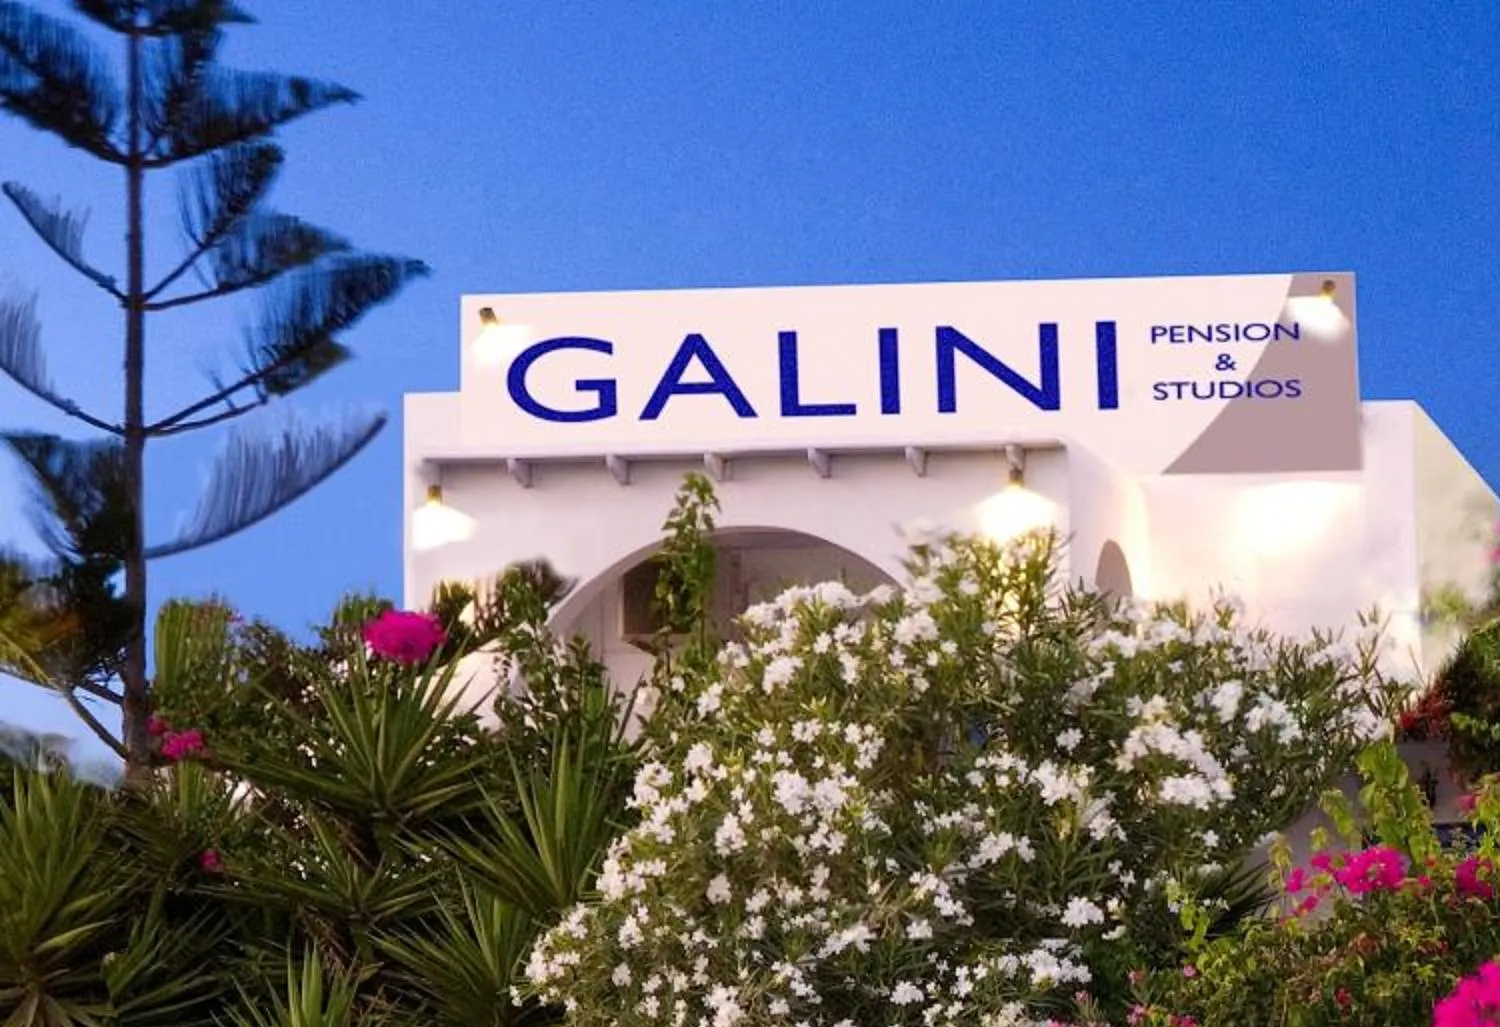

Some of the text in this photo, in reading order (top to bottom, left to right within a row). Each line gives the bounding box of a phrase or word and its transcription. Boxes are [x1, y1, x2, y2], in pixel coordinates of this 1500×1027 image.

[1150, 322, 1300, 344] PENSION
[506, 320, 1120, 424] GALINI
[1214, 353, 1237, 371] &
[1152, 379, 1302, 401] STUDIOS
